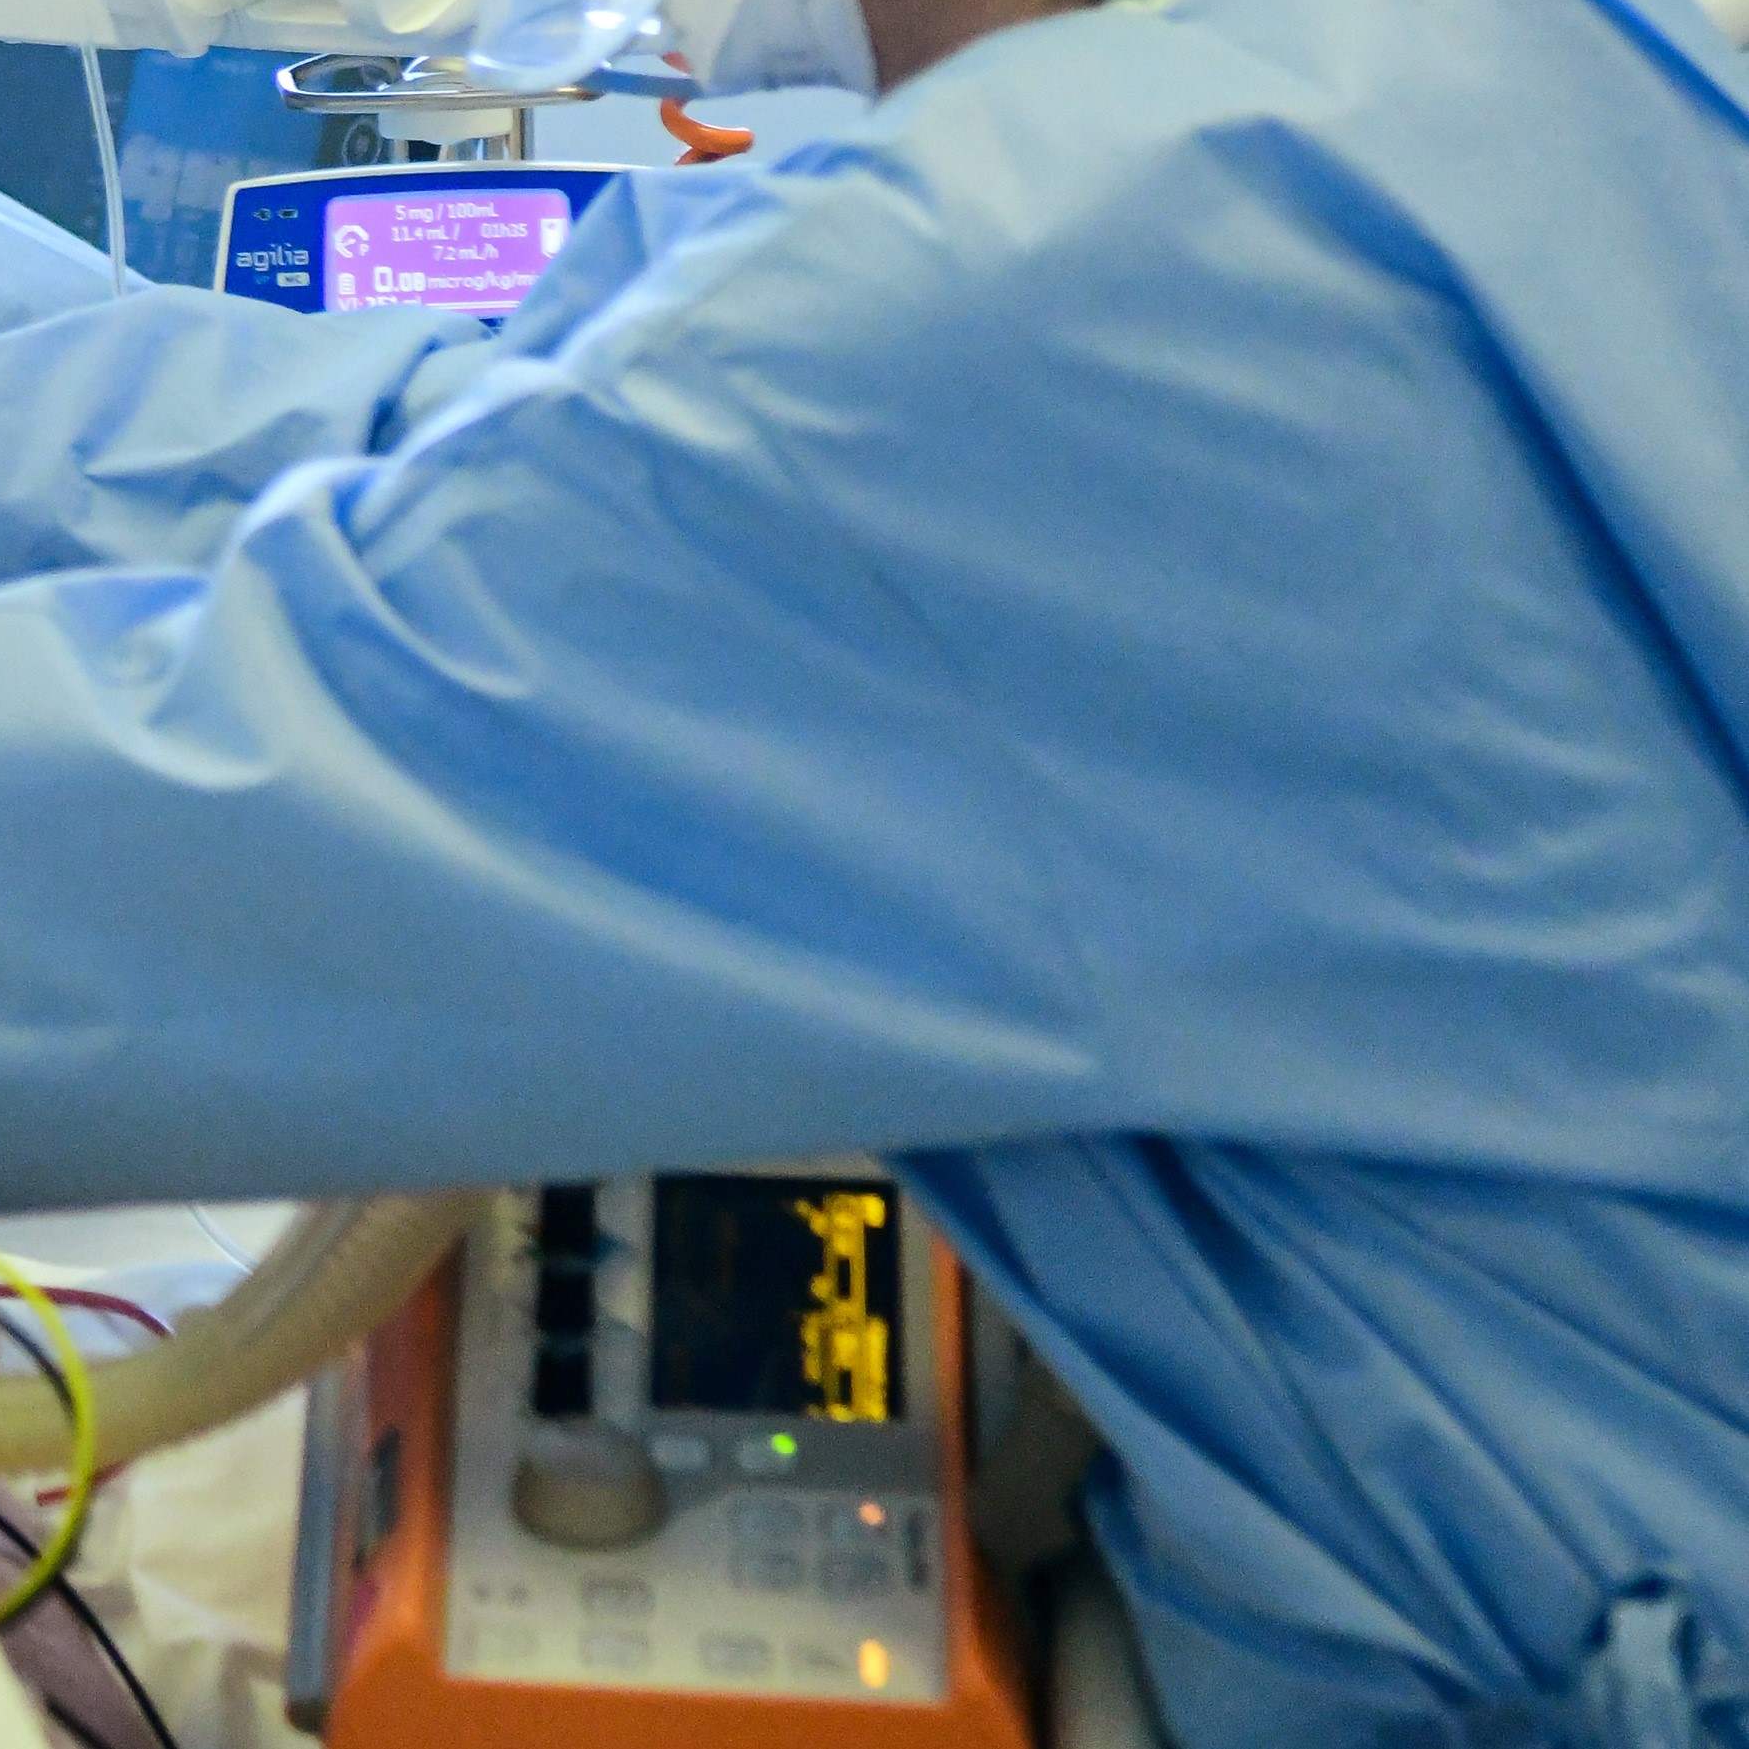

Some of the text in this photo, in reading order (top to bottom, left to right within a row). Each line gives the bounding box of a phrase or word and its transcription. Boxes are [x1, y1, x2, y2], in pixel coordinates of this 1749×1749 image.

[395, 204, 406, 221] 5
[409, 208, 434, 223] mg
[236, 242, 310, 272] agilia
